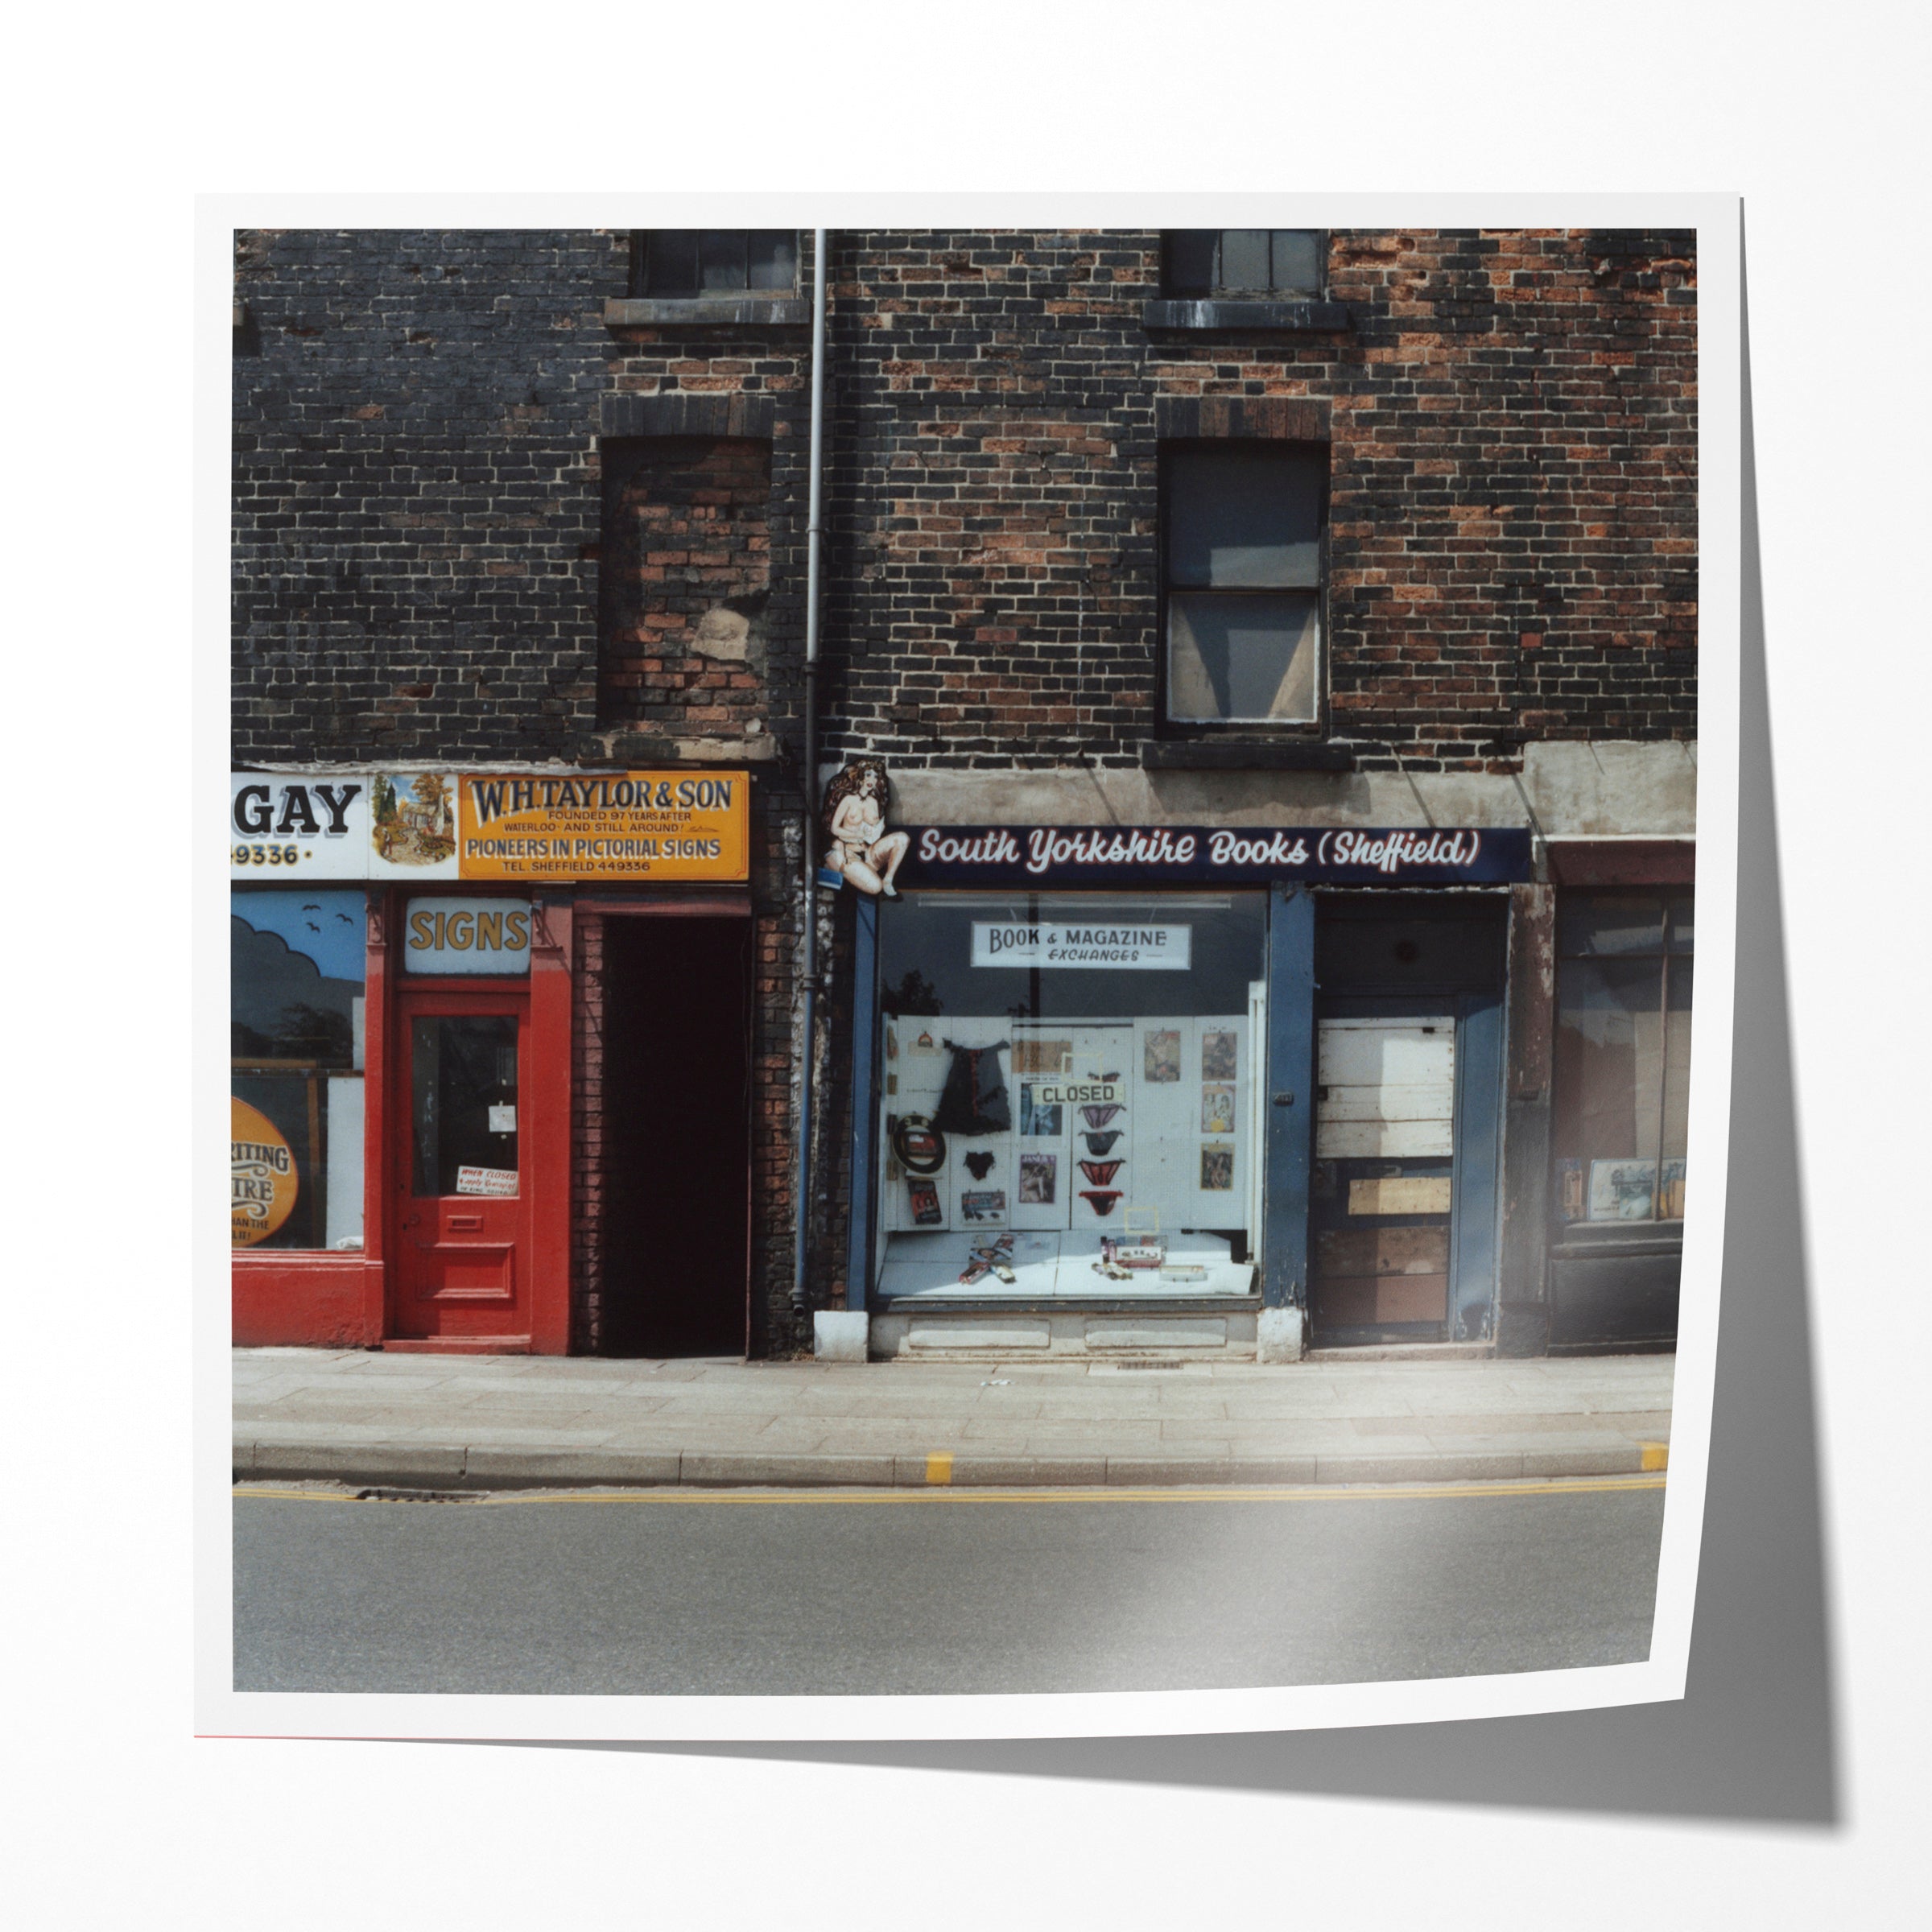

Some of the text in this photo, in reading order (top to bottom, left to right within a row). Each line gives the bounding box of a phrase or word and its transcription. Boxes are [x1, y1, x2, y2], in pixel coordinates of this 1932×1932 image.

[655, 781, 673, 807] &
[678, 780, 732, 808] SON
[231, 784, 361, 835] GAY
[548, 811, 691, 821] FOUNDED 97 YEARS AFTER
[564, 823, 590, 832] AND
[595, 823, 624, 832] STILL
[629, 824, 683, 832] AROUND!
[230, 844, 299, 866] 9336
[466, 839, 721, 859] PIONEERS IN PICTORIAL SIGNS
[919, 828, 1480, 874] South Yorkshire Books (Sheffield)
[531, 861, 594, 871] SHEFFIELD
[597, 861, 650, 871] 449336
[408, 910, 530, 951] SIGNS
[990, 928, 1167, 954] BOOK & MAGAZINE
[1048, 949, 1139, 961] EXCHANGES
[1042, 1086, 1114, 1103] CLOSED
[486, 1170, 517, 1180] CLOSED
[250, 1220, 269, 1229] THE
